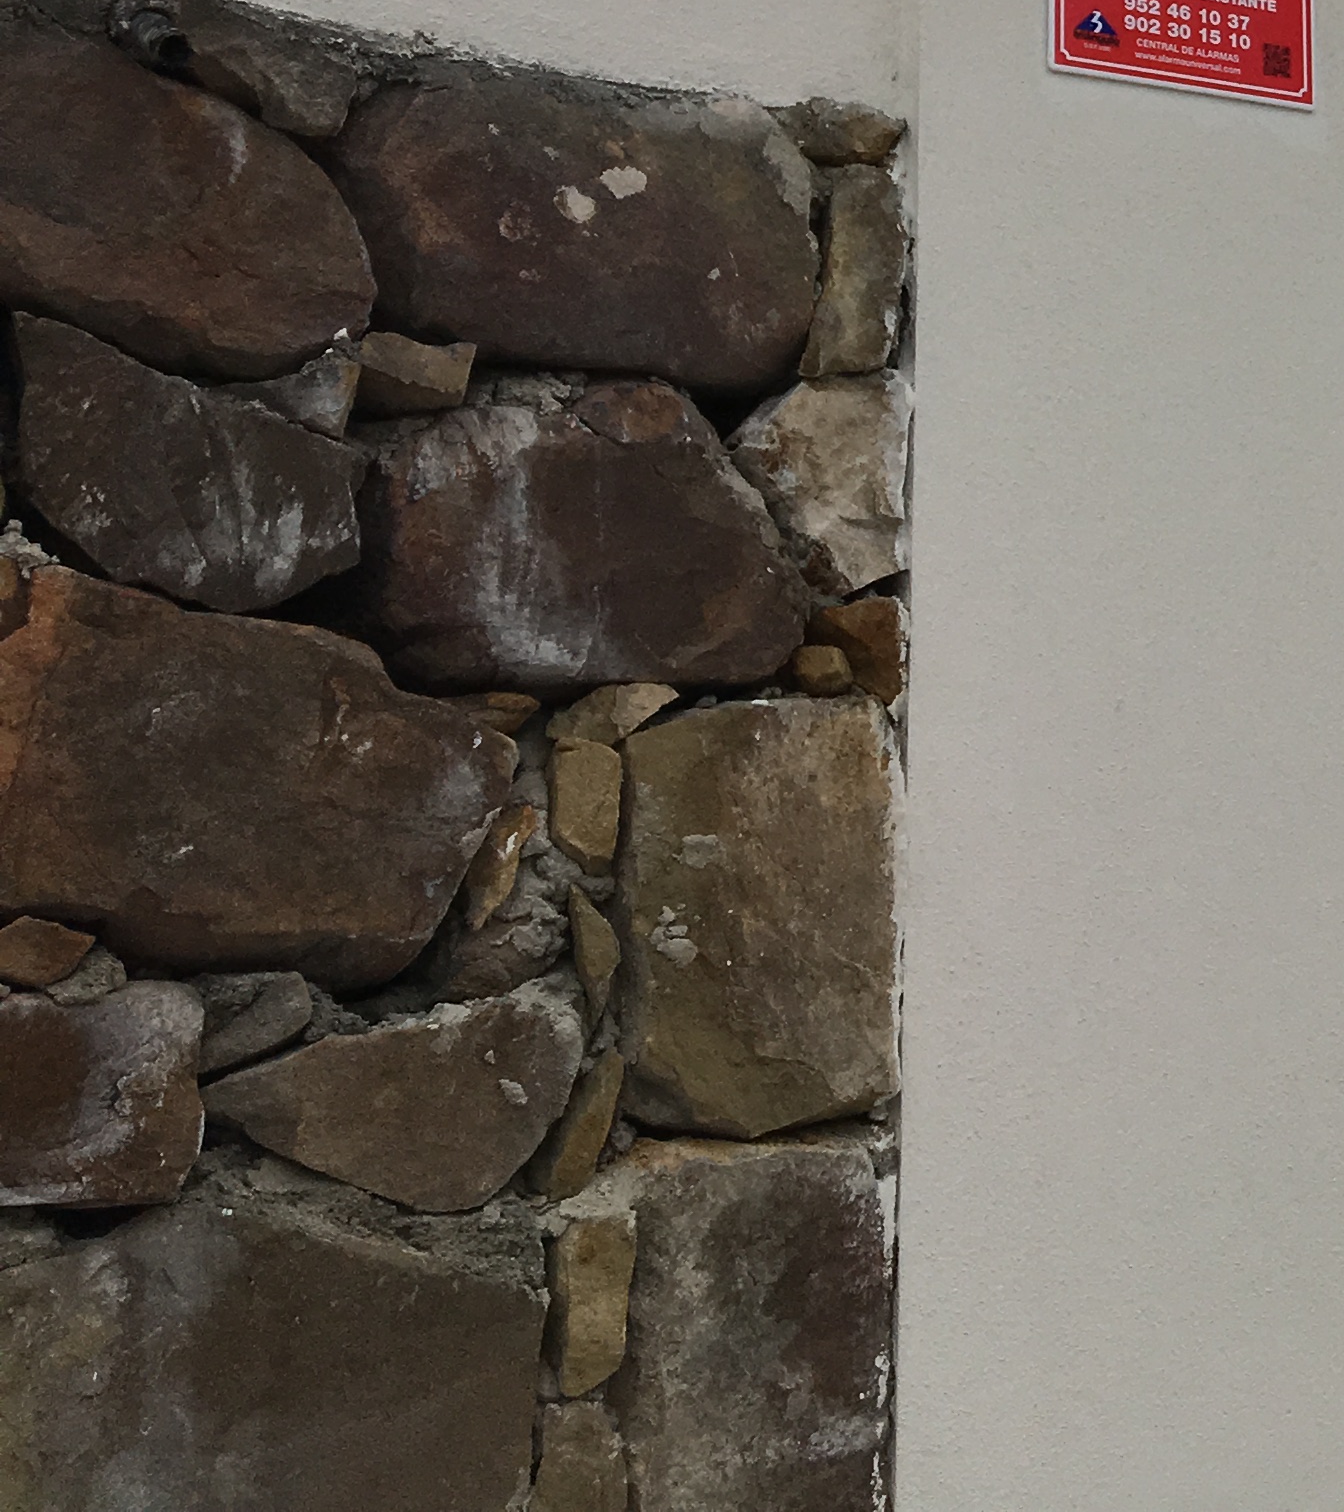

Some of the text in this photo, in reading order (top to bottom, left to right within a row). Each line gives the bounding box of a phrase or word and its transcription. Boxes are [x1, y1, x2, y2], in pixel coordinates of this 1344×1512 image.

[1167, 3, 1191, 20] 46
[1198, 8, 1221, 26] 10
[1227, 13, 1250, 30] 37
[1123, 14, 1251, 50] 902 30 15 10
[1135, 37, 1179, 53] CENTRAL
[1181, 45, 1194, 55] DE
[1196, 48, 1239, 63] ALARMAS
